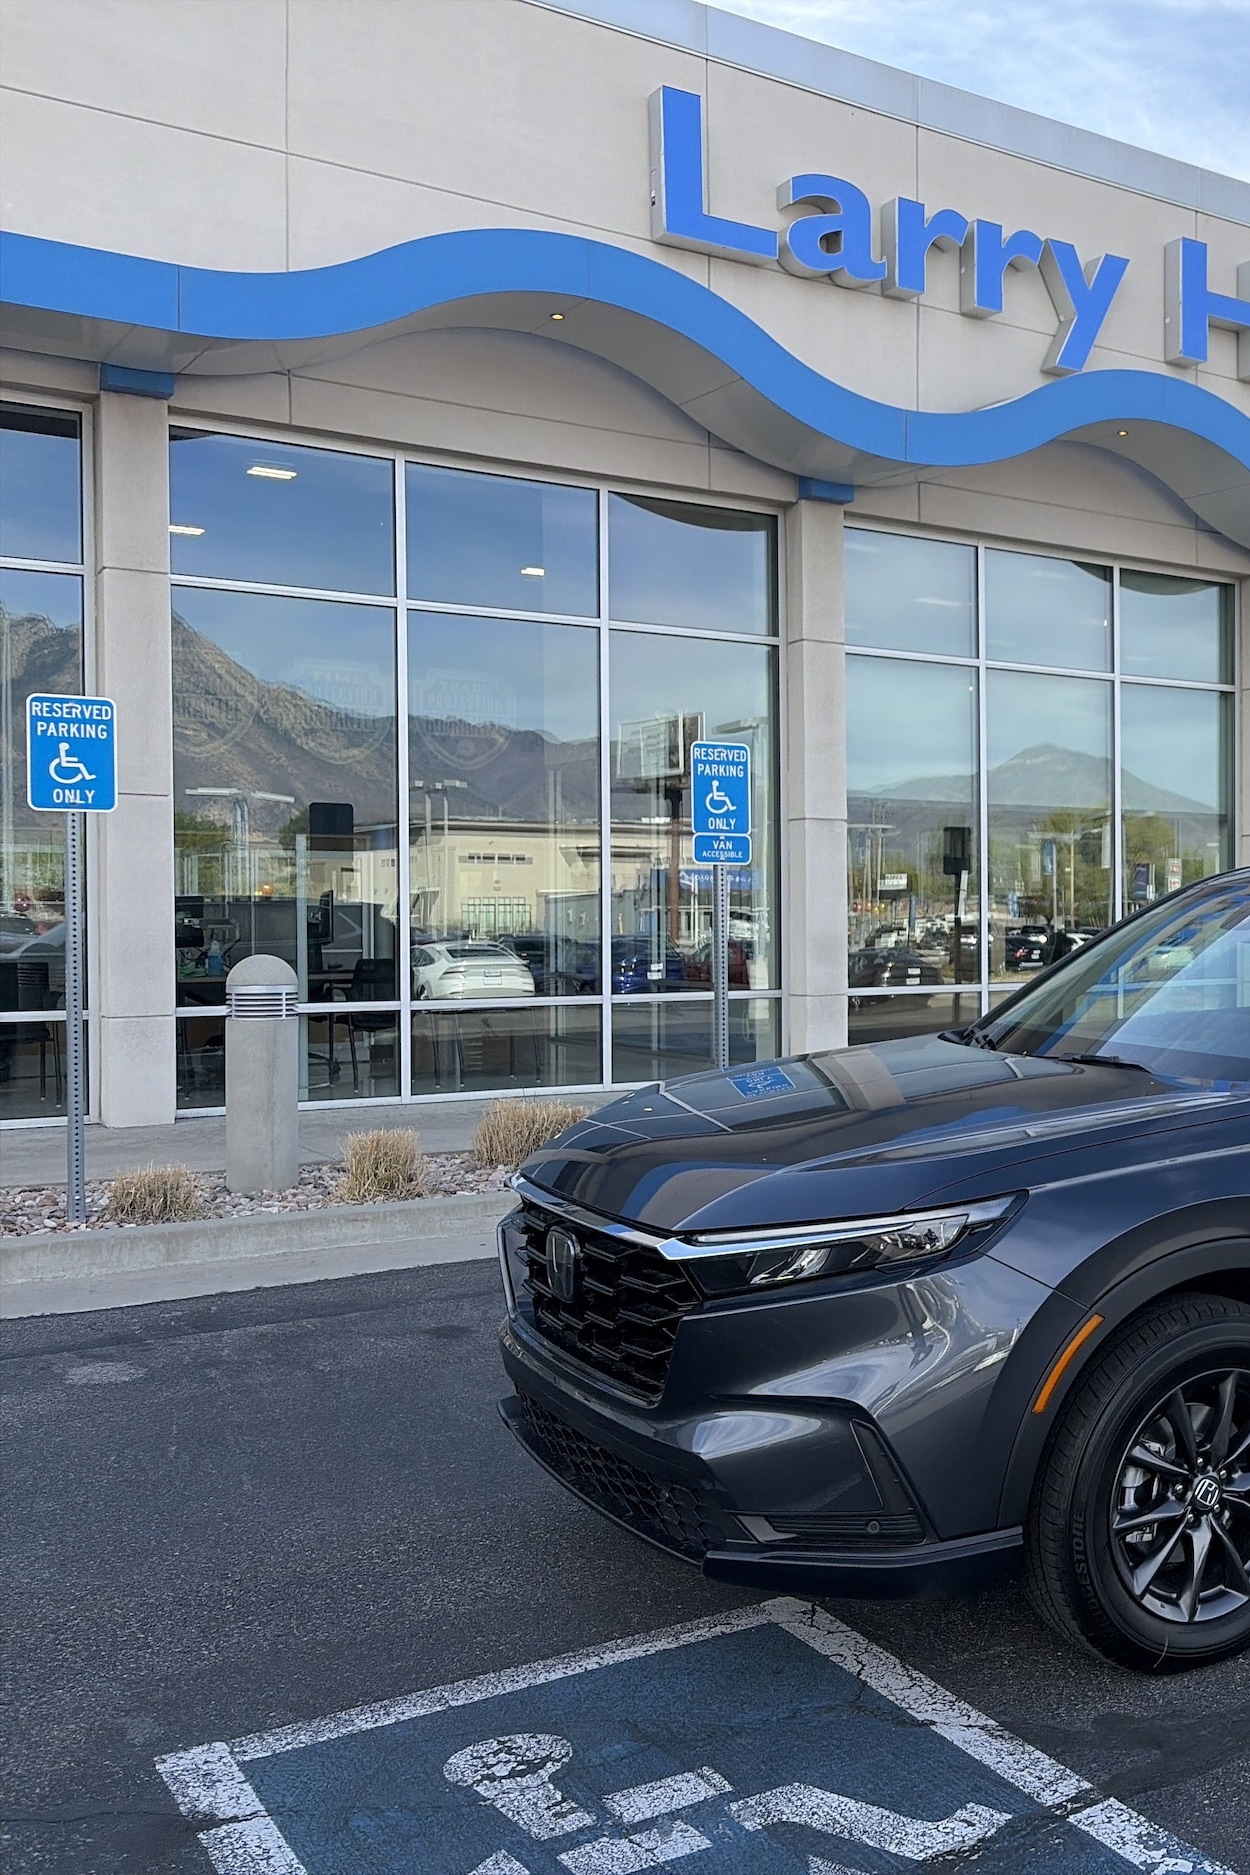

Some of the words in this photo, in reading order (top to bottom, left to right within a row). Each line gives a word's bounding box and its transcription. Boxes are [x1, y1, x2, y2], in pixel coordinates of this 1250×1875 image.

[650, 85, 1130, 373] Larry
[31, 701, 112, 720] RESERVED
[36, 721, 108, 739] PARKING
[693, 747, 747, 763] RESERVED
[697, 763, 744, 778] PARKING
[52, 788, 95, 804] ONLY
[708, 817, 736, 830] ONLY
[712, 840, 733, 851] VAN
[702, 850, 743, 859] ACCESSIBLE
